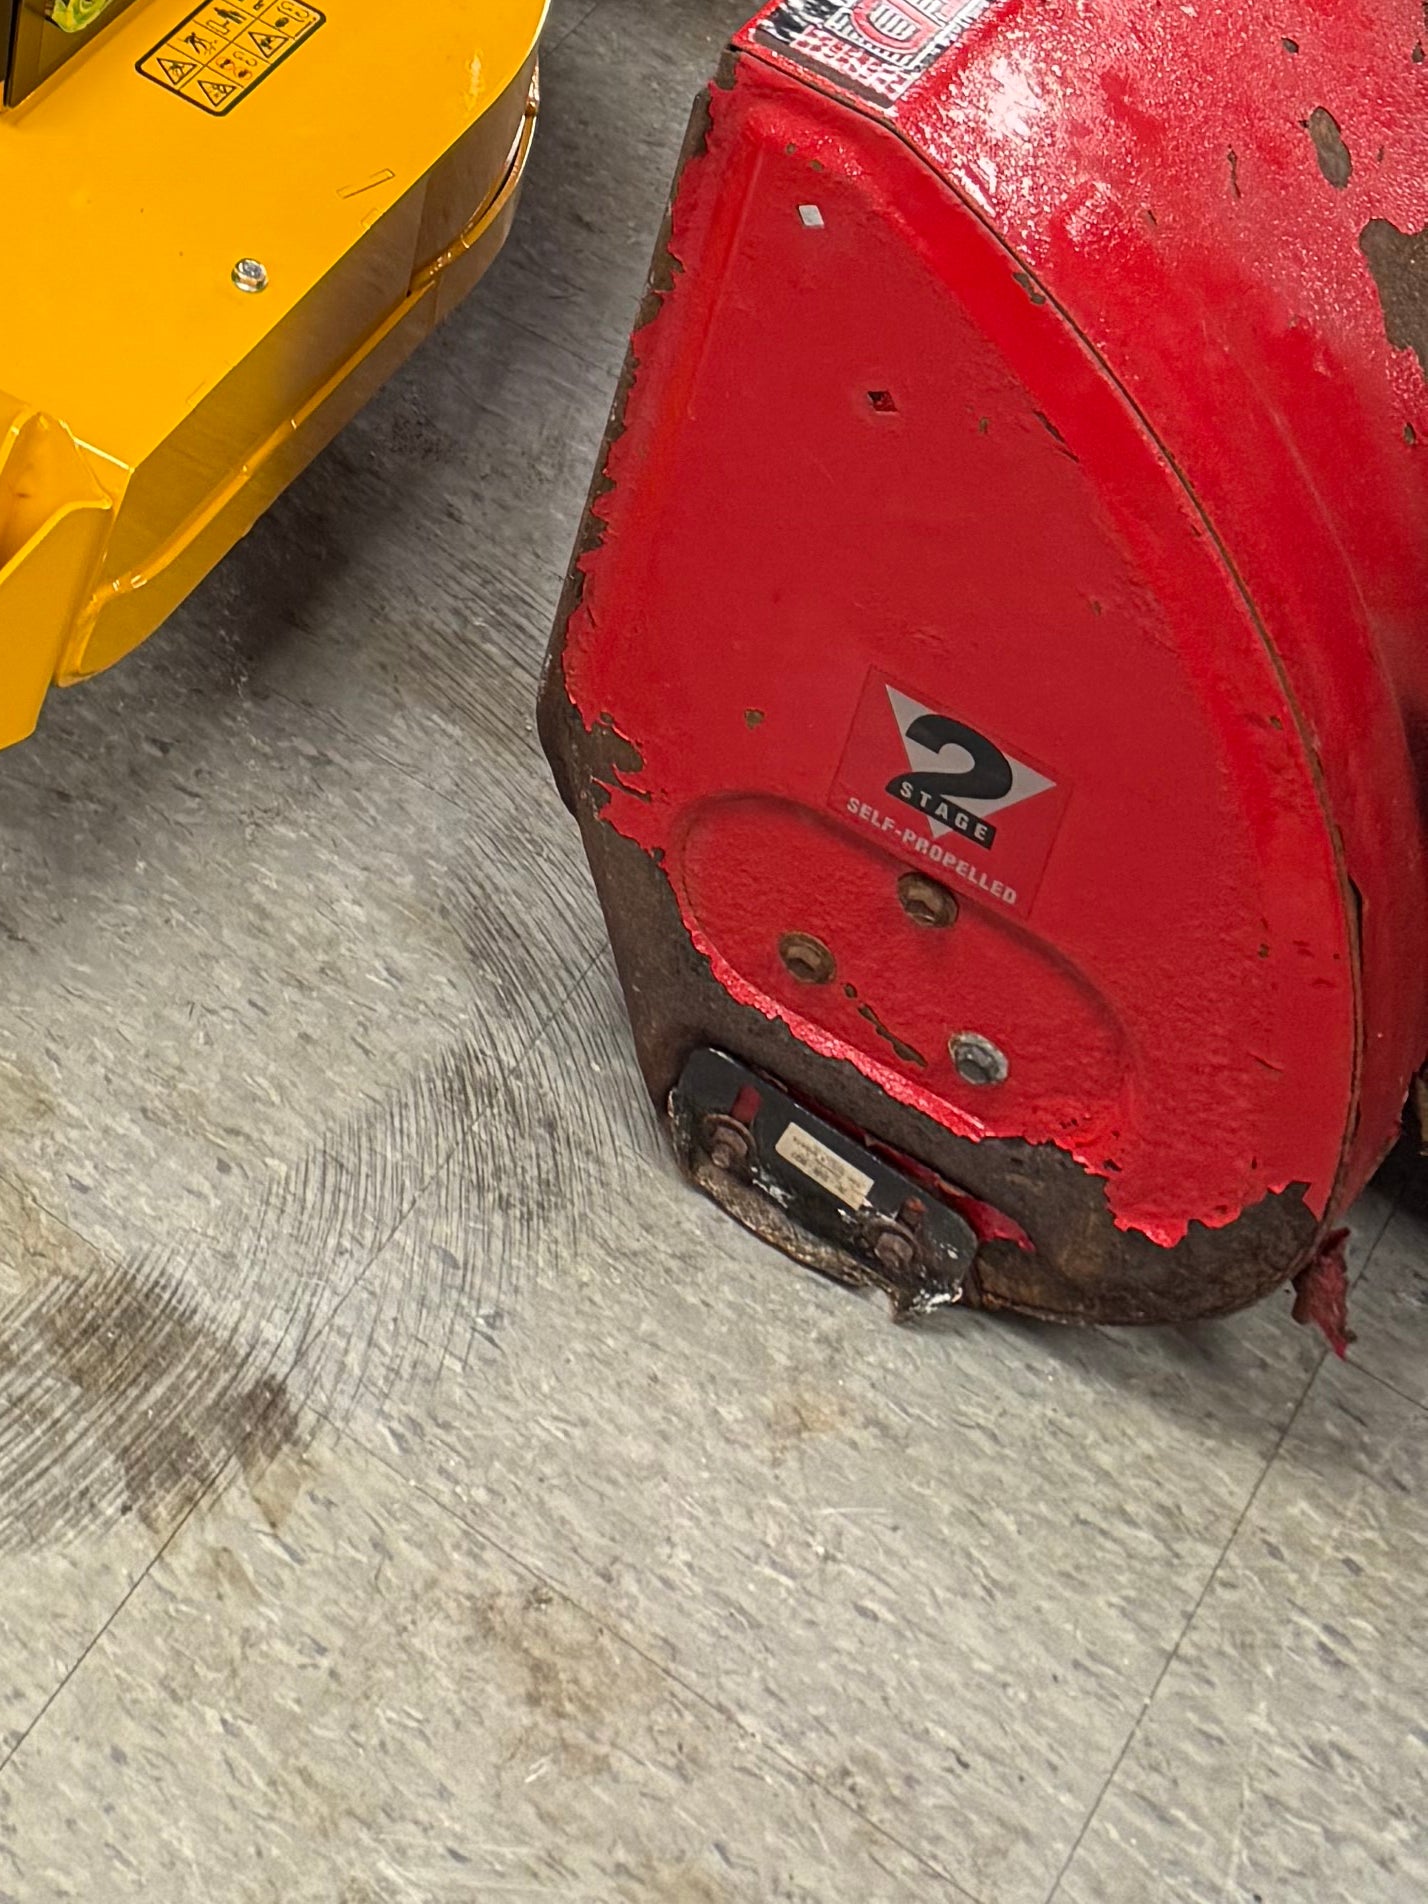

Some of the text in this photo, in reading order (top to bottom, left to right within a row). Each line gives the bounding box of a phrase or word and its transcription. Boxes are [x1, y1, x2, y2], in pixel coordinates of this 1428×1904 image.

[884, 713, 1014, 800] 2
[846, 796, 1018, 906] SELF-PROPELLED
[899, 780, 989, 842] STAGE
